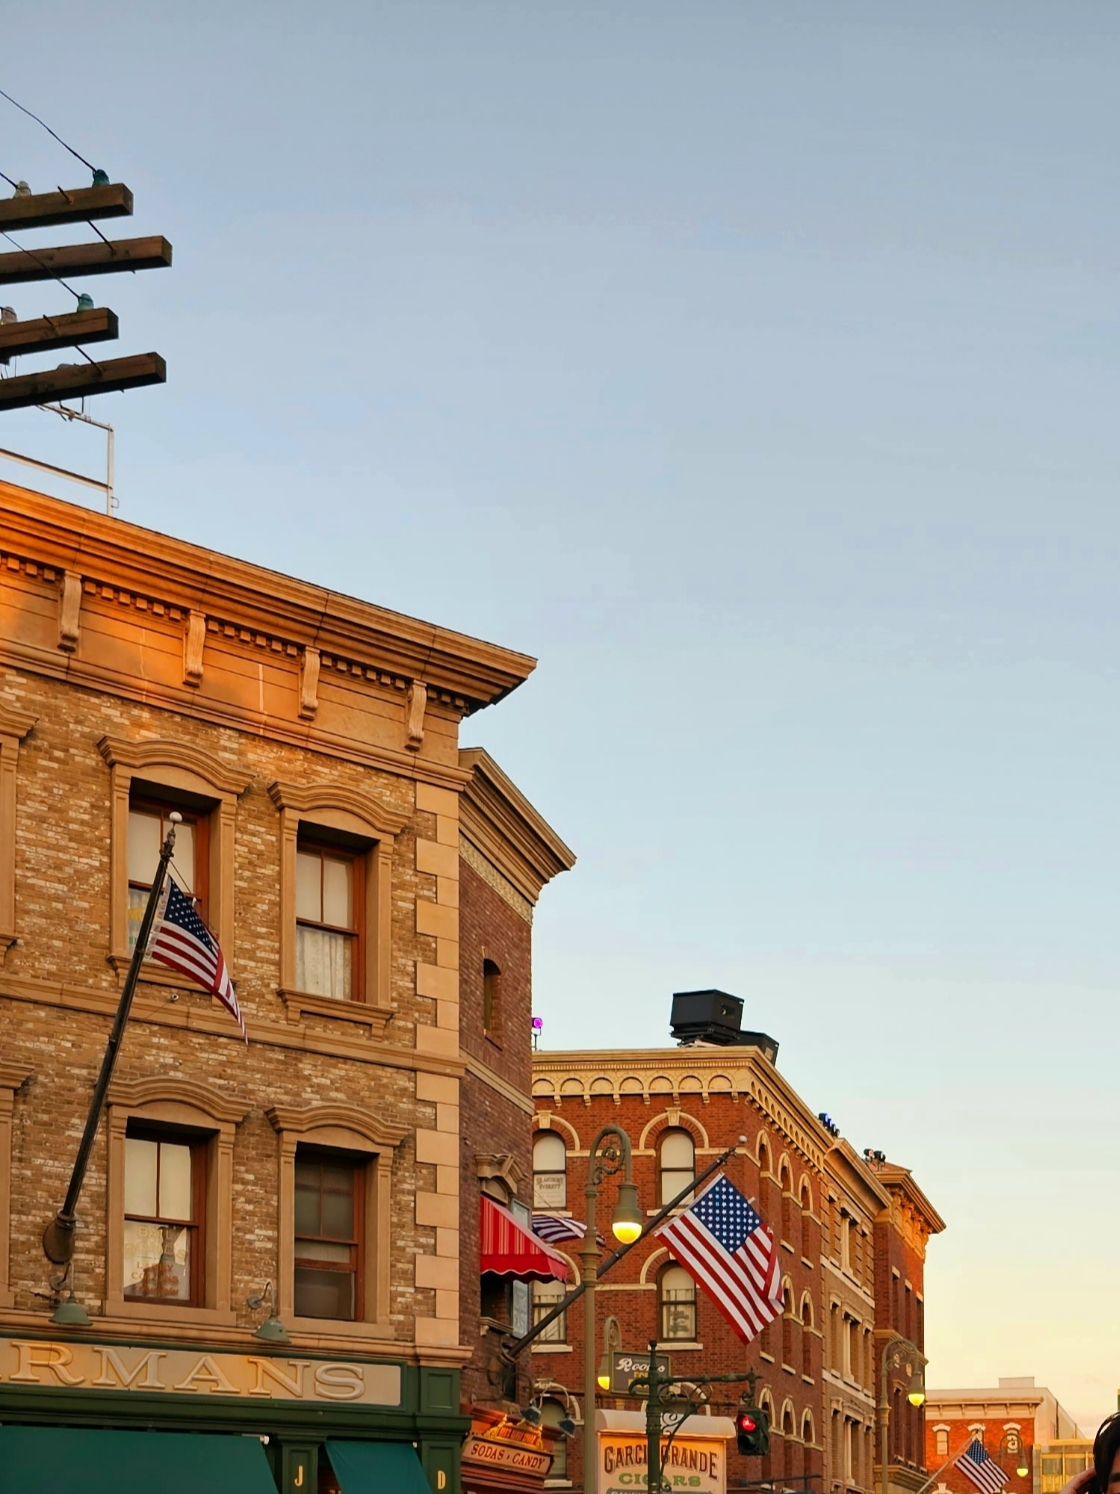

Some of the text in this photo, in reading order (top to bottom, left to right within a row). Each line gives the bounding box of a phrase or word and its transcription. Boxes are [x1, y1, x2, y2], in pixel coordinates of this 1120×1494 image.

[0, 1341, 365, 1399] RMANS
[615, 1357, 666, 1373] Roos
[470, 1443, 546, 1470] SODAS CANDY
[604, 1444, 647, 1474] GARCI
